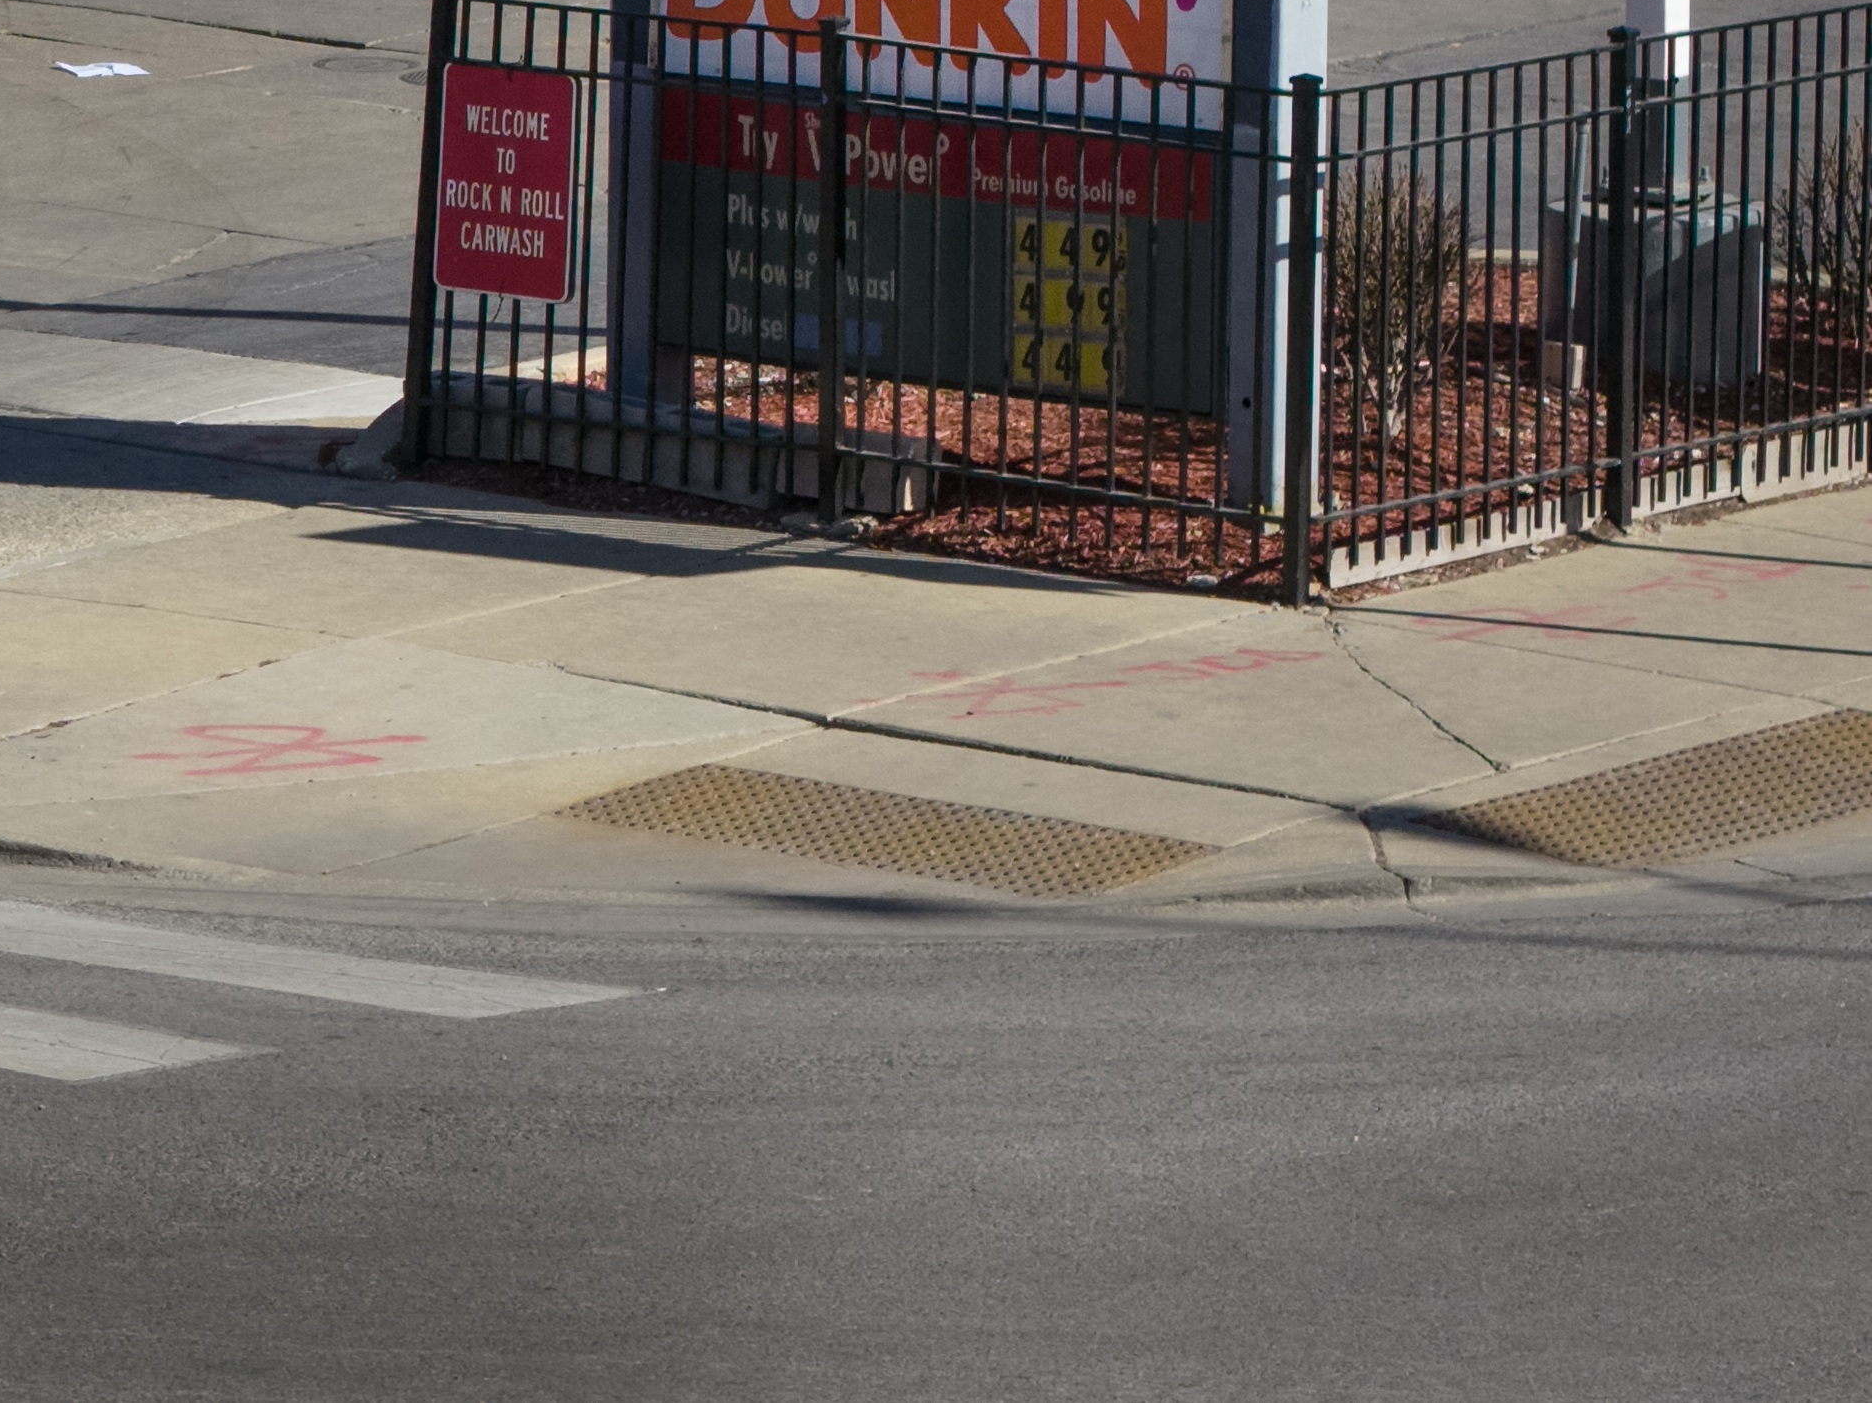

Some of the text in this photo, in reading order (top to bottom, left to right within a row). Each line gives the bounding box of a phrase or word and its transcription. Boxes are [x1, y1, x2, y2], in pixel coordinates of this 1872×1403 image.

[466, 103, 550, 141] WELCOME
[496, 148, 516, 176] TO
[445, 181, 565, 221] ROCK N ROLL
[461, 222, 545, 260] CARWASH
